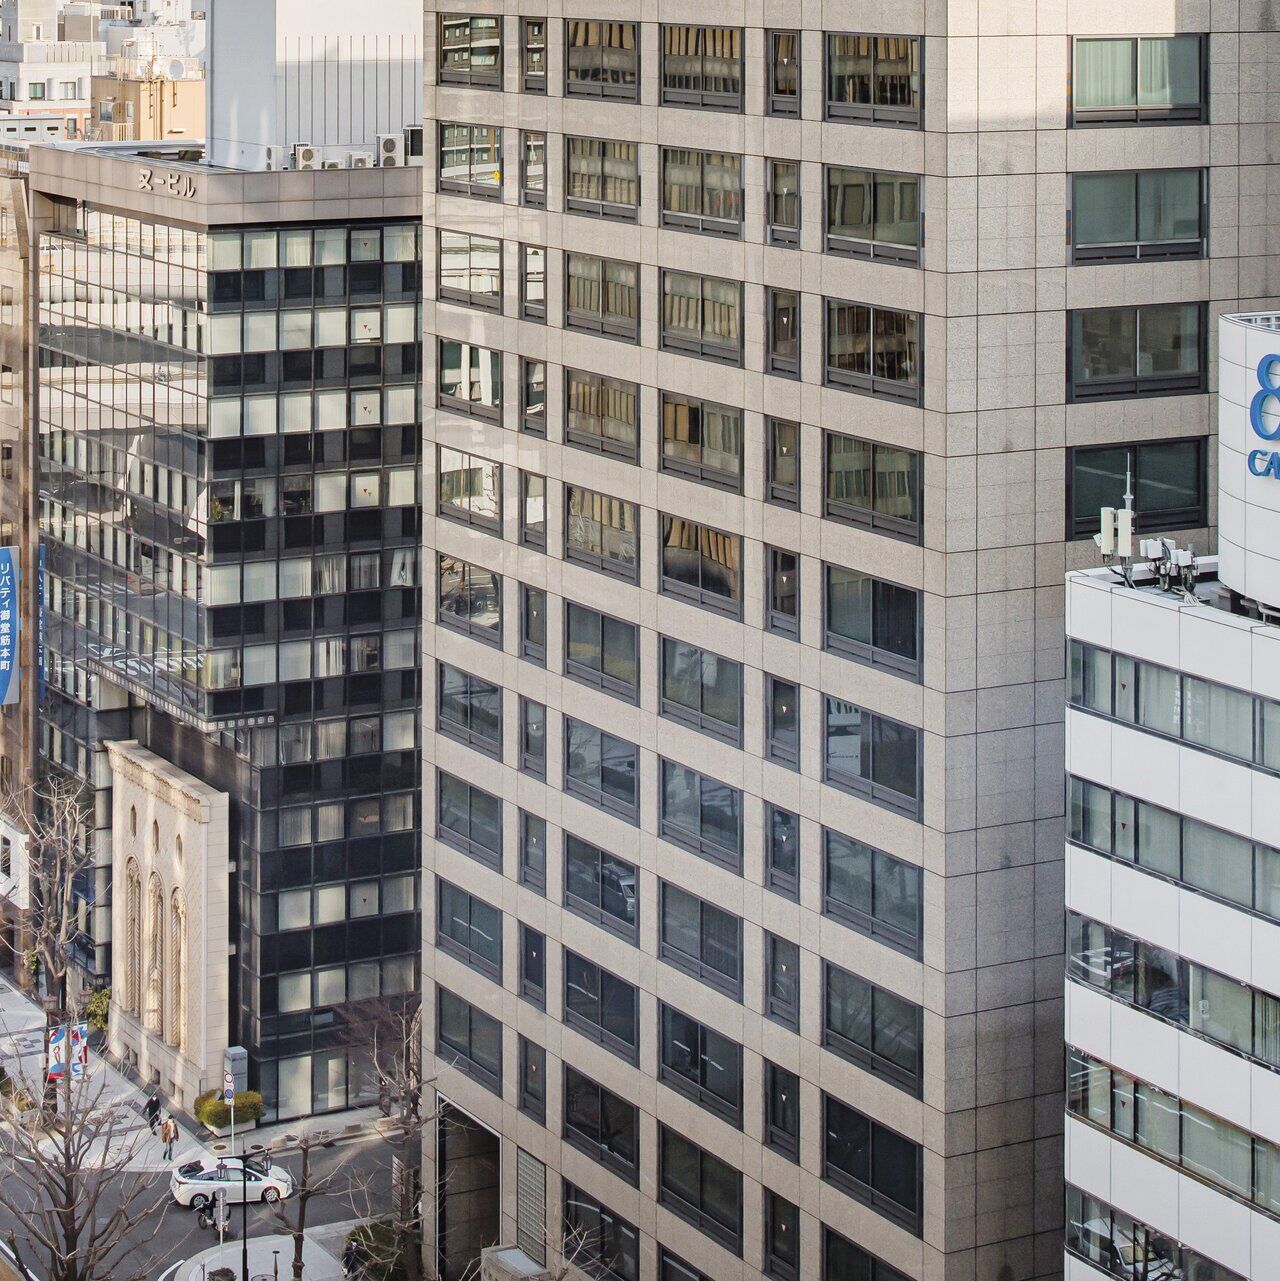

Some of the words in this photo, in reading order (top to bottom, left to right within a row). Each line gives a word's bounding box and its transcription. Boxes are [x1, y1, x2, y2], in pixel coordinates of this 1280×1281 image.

[0, 562, 11, 671] リバティ御堂筋本町
